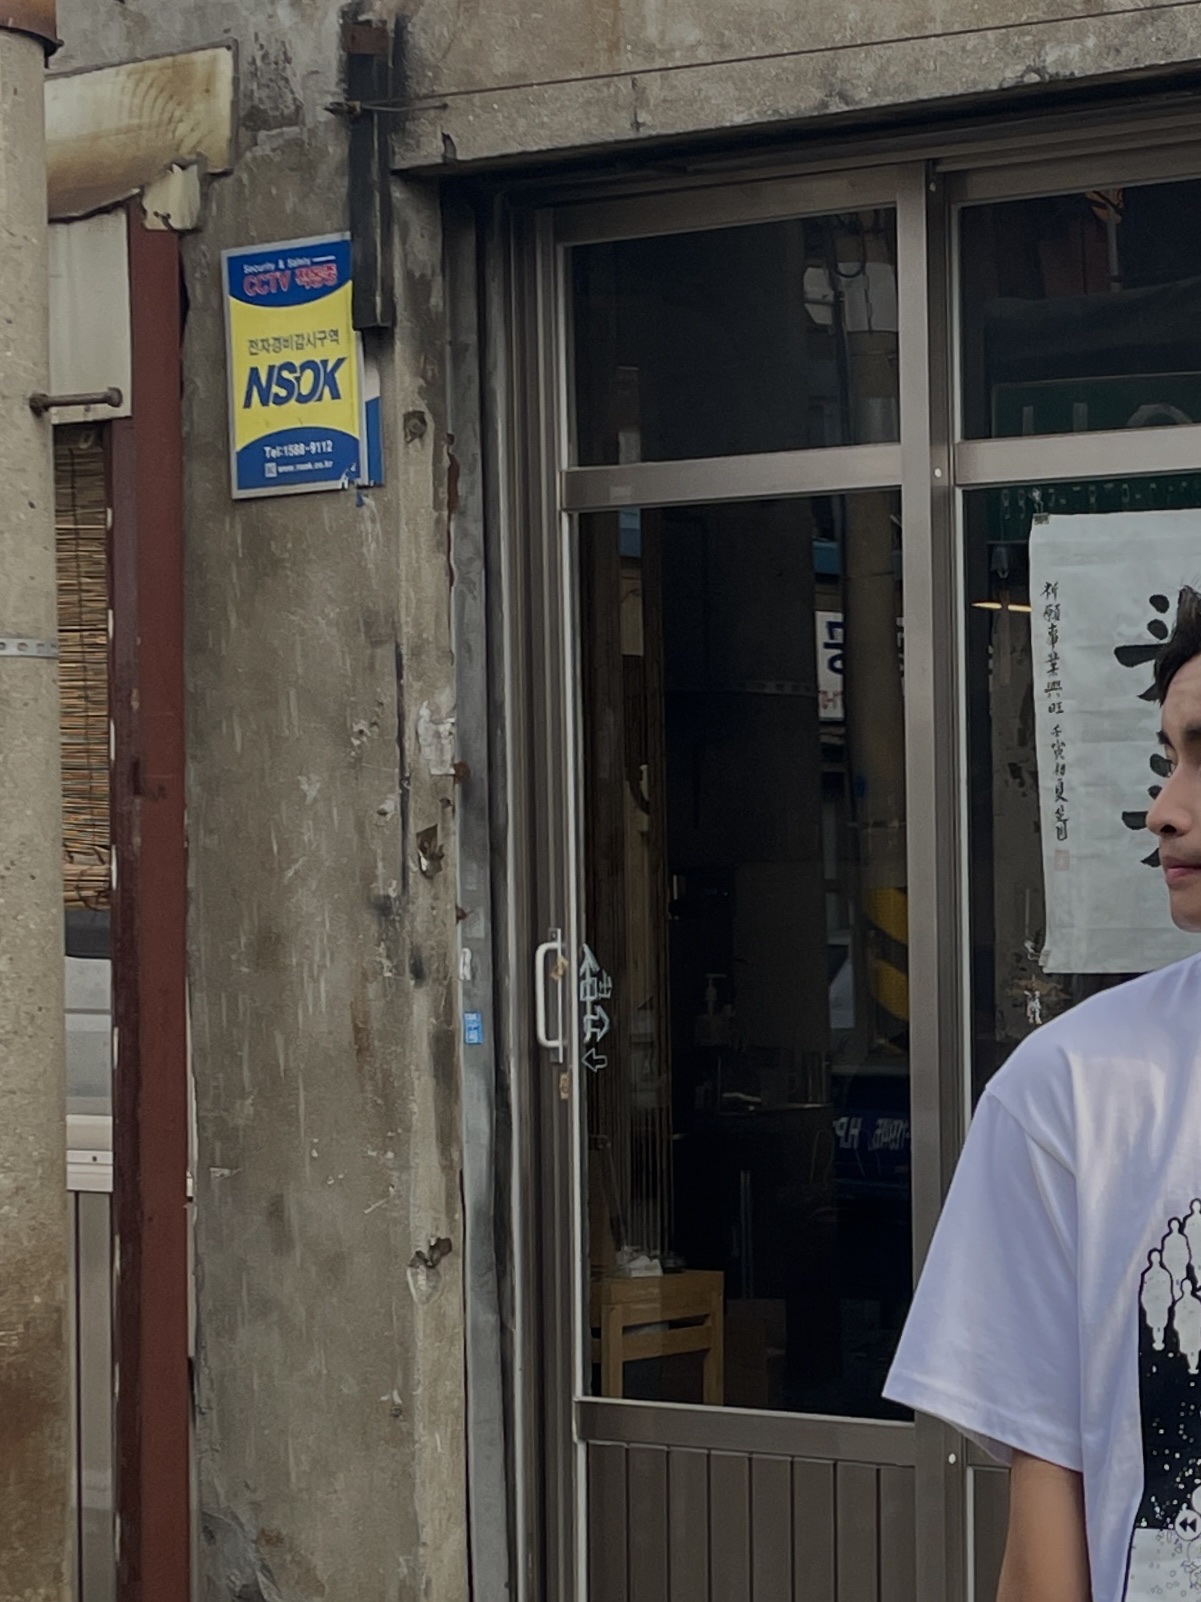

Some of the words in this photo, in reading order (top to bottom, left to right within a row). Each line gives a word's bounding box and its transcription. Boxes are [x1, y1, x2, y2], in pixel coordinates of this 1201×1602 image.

[243, 270, 291, 297] CCTV
[247, 328, 340, 356] 전자경비감시구역
[243, 357, 347, 409] NSOK
